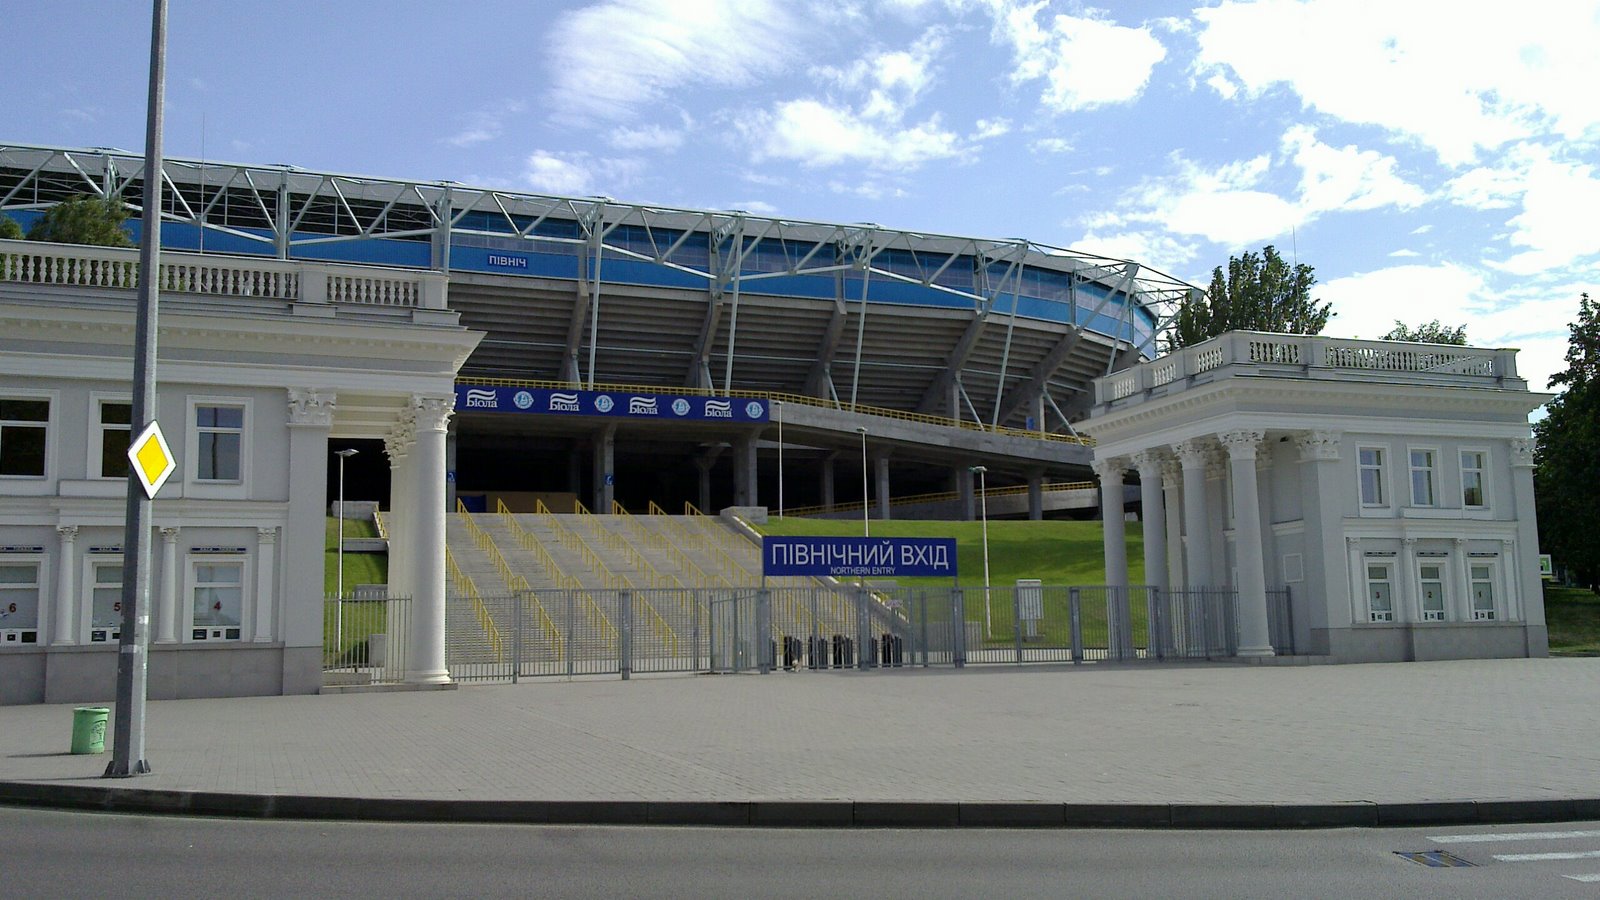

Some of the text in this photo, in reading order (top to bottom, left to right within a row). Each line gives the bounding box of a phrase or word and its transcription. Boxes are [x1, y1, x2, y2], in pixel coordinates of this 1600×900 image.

[489, 255, 526, 267] ПІВНІЧ
[772, 540, 949, 570] ПІВНІЧНИЙ ВХІД
[830, 566, 896, 575] NORTHERN ENTRY
[9, 602, 17, 613] 6
[114, 602, 121, 612] 5
[213, 601, 222, 611] 4
